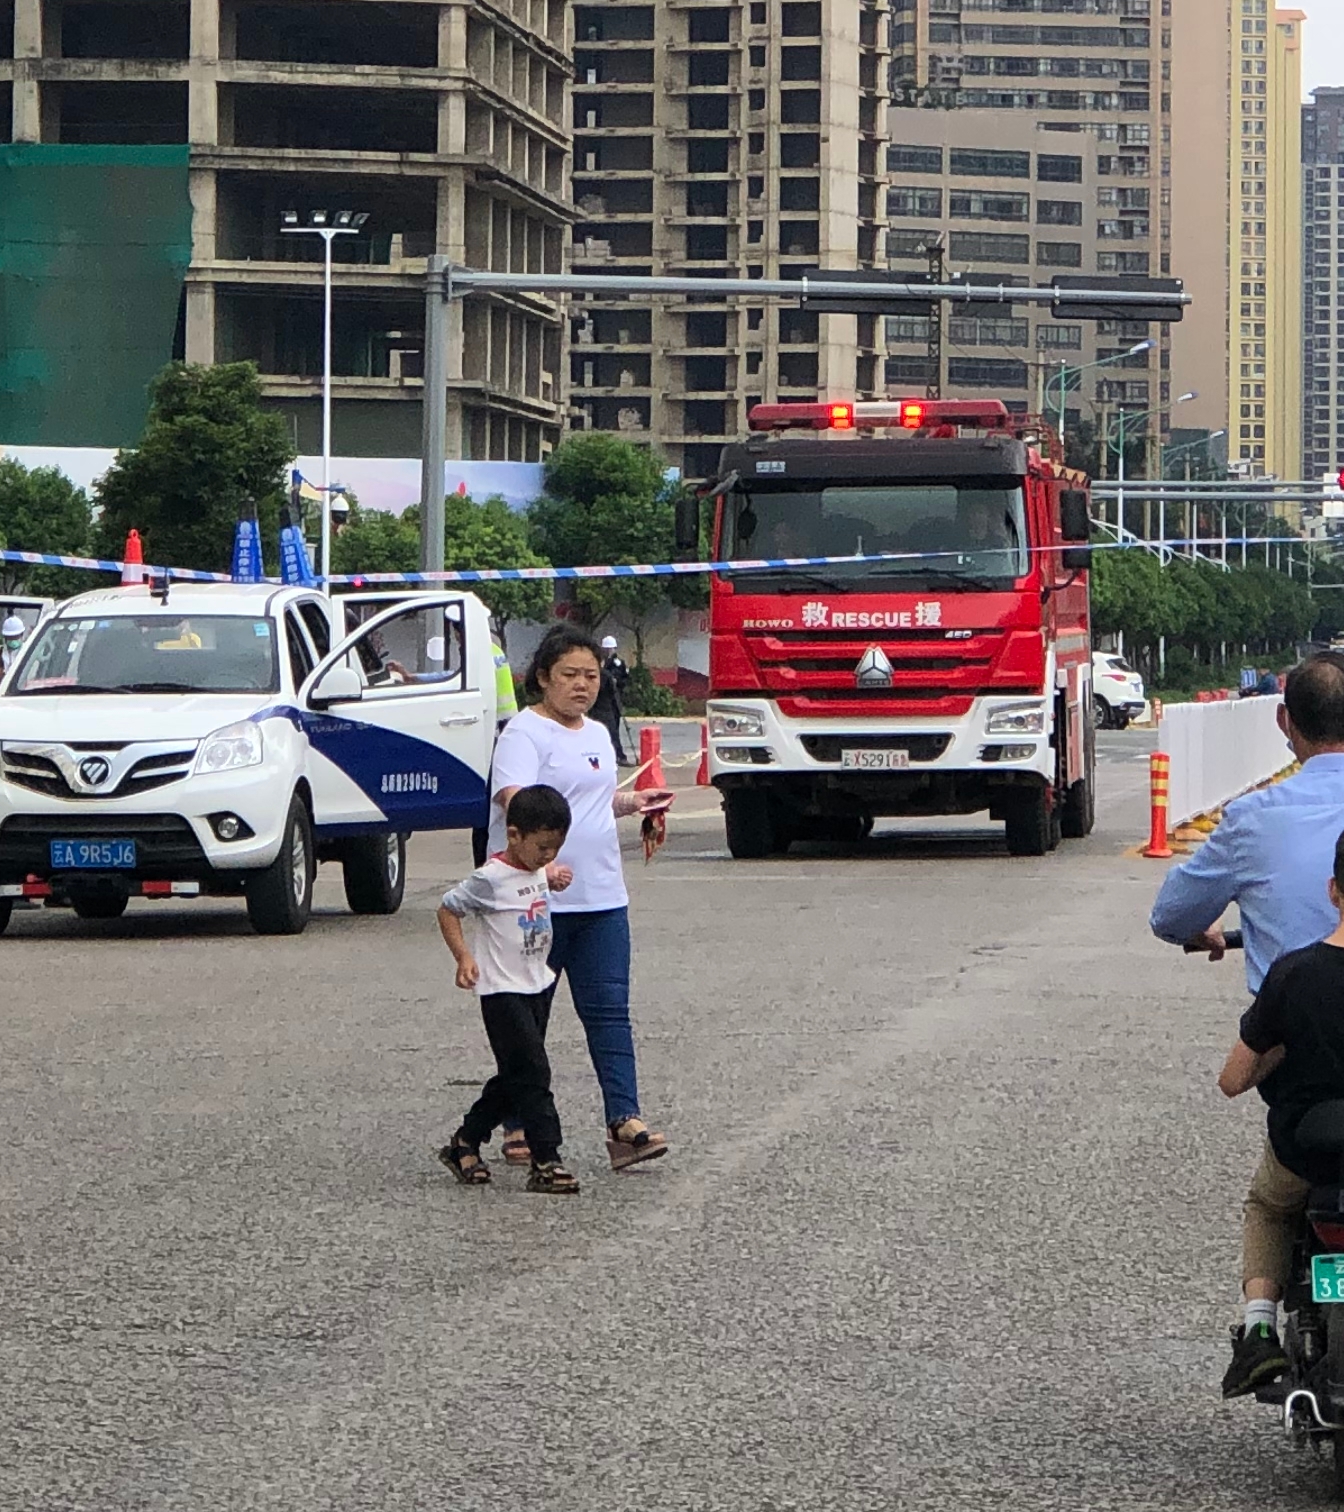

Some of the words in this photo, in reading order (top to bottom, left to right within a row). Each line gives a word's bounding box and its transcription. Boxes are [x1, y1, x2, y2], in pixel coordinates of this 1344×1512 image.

[742, 619, 794, 628] HOWO
[802, 602, 828, 628] 救
[832, 612, 912, 628] RESCUE
[915, 601, 942, 628] 援
